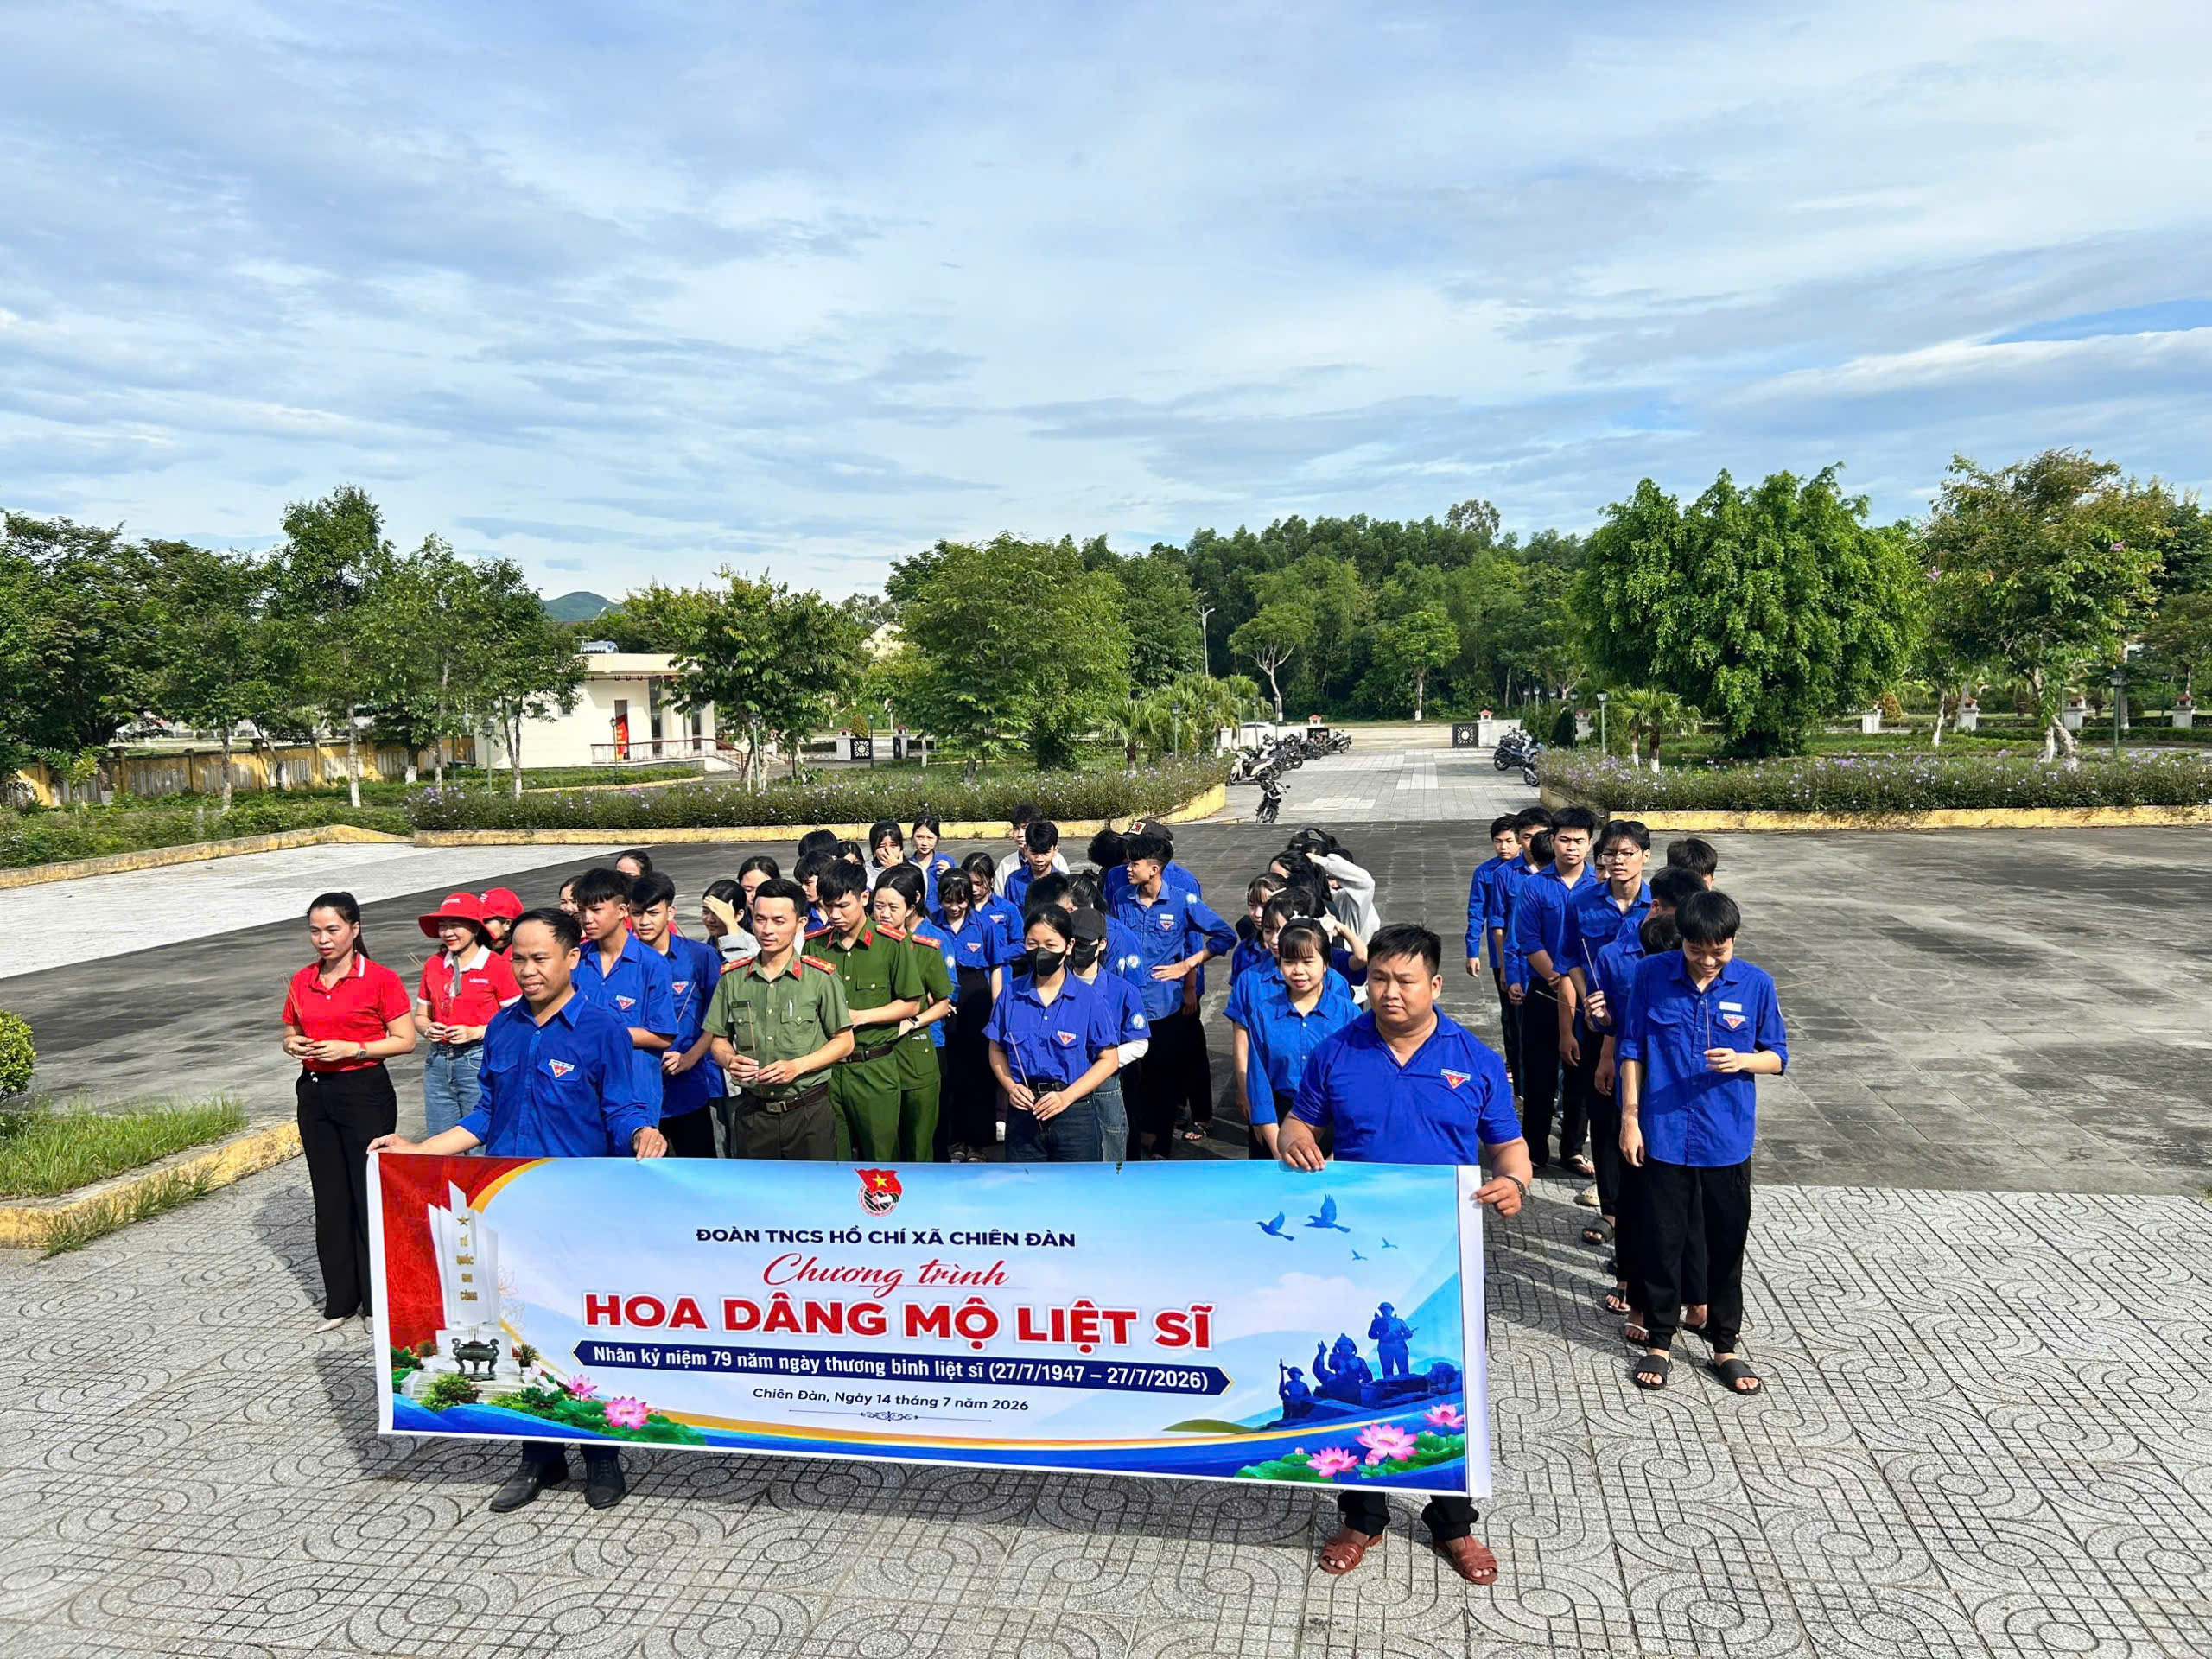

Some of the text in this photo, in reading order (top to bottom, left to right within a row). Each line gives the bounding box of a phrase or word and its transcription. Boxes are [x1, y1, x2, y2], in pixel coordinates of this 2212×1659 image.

[696, 1224, 1076, 1247] ĐOÀN TNCS HỒ CHÍ XÃ CHIÊN ĐÀN
[763, 1252, 1009, 1299] Chương trình
[585, 1292, 1214, 1354] HOA DÂNG MỘ LIỆT SĨ
[594, 1346, 636, 1363] Nhân
[641, 1348, 660, 1367] kỷ
[666, 1350, 706, 1369] niệm
[712, 1351, 732, 1366] 79
[737, 1353, 773, 1369] năm
[779, 1355, 820, 1374] ngày
[825, 1357, 886, 1377] thương
[892, 1359, 929, 1376] binh
[935, 1361, 963, 1380] liệt
[969, 1363, 984, 1378] sĩ
[989, 1363, 1084, 1382] (27/7/1947
[1107, 1367, 1209, 1392] 27/7/2026)
[753, 1388, 1029, 1411] Chiên Đàn, Ngày 14 tháng 7 năm 2026
